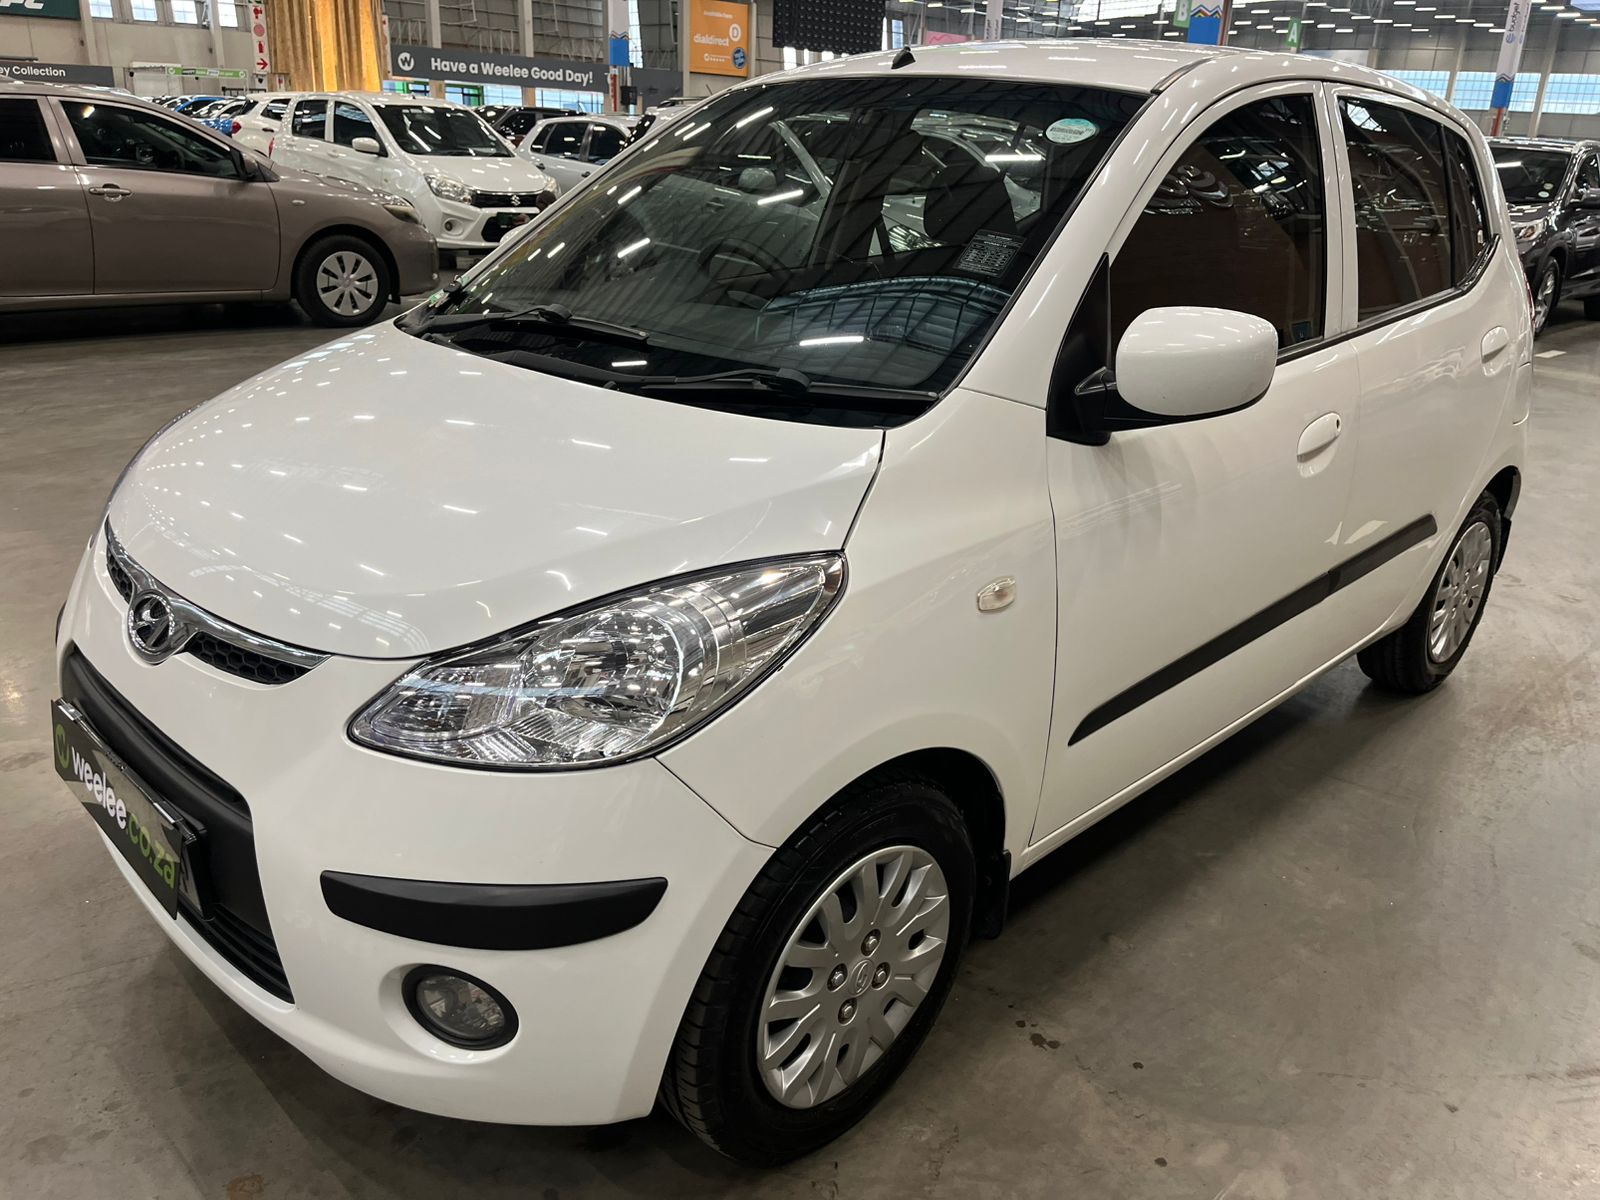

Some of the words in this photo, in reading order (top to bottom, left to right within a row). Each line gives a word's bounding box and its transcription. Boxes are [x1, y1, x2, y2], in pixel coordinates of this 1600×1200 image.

[1177, 0, 1189, 21] B
[1288, 23, 1298, 43] A
[12, 65, 66, 77] Collection
[430, 57, 467, 73] Have
[469, 63, 478, 74] a
[481, 62, 529, 78] Weelee
[531, 66, 564, 81] Good
[566, 69, 594, 87] Day!
[71, 746, 176, 889] weelee.co.za
